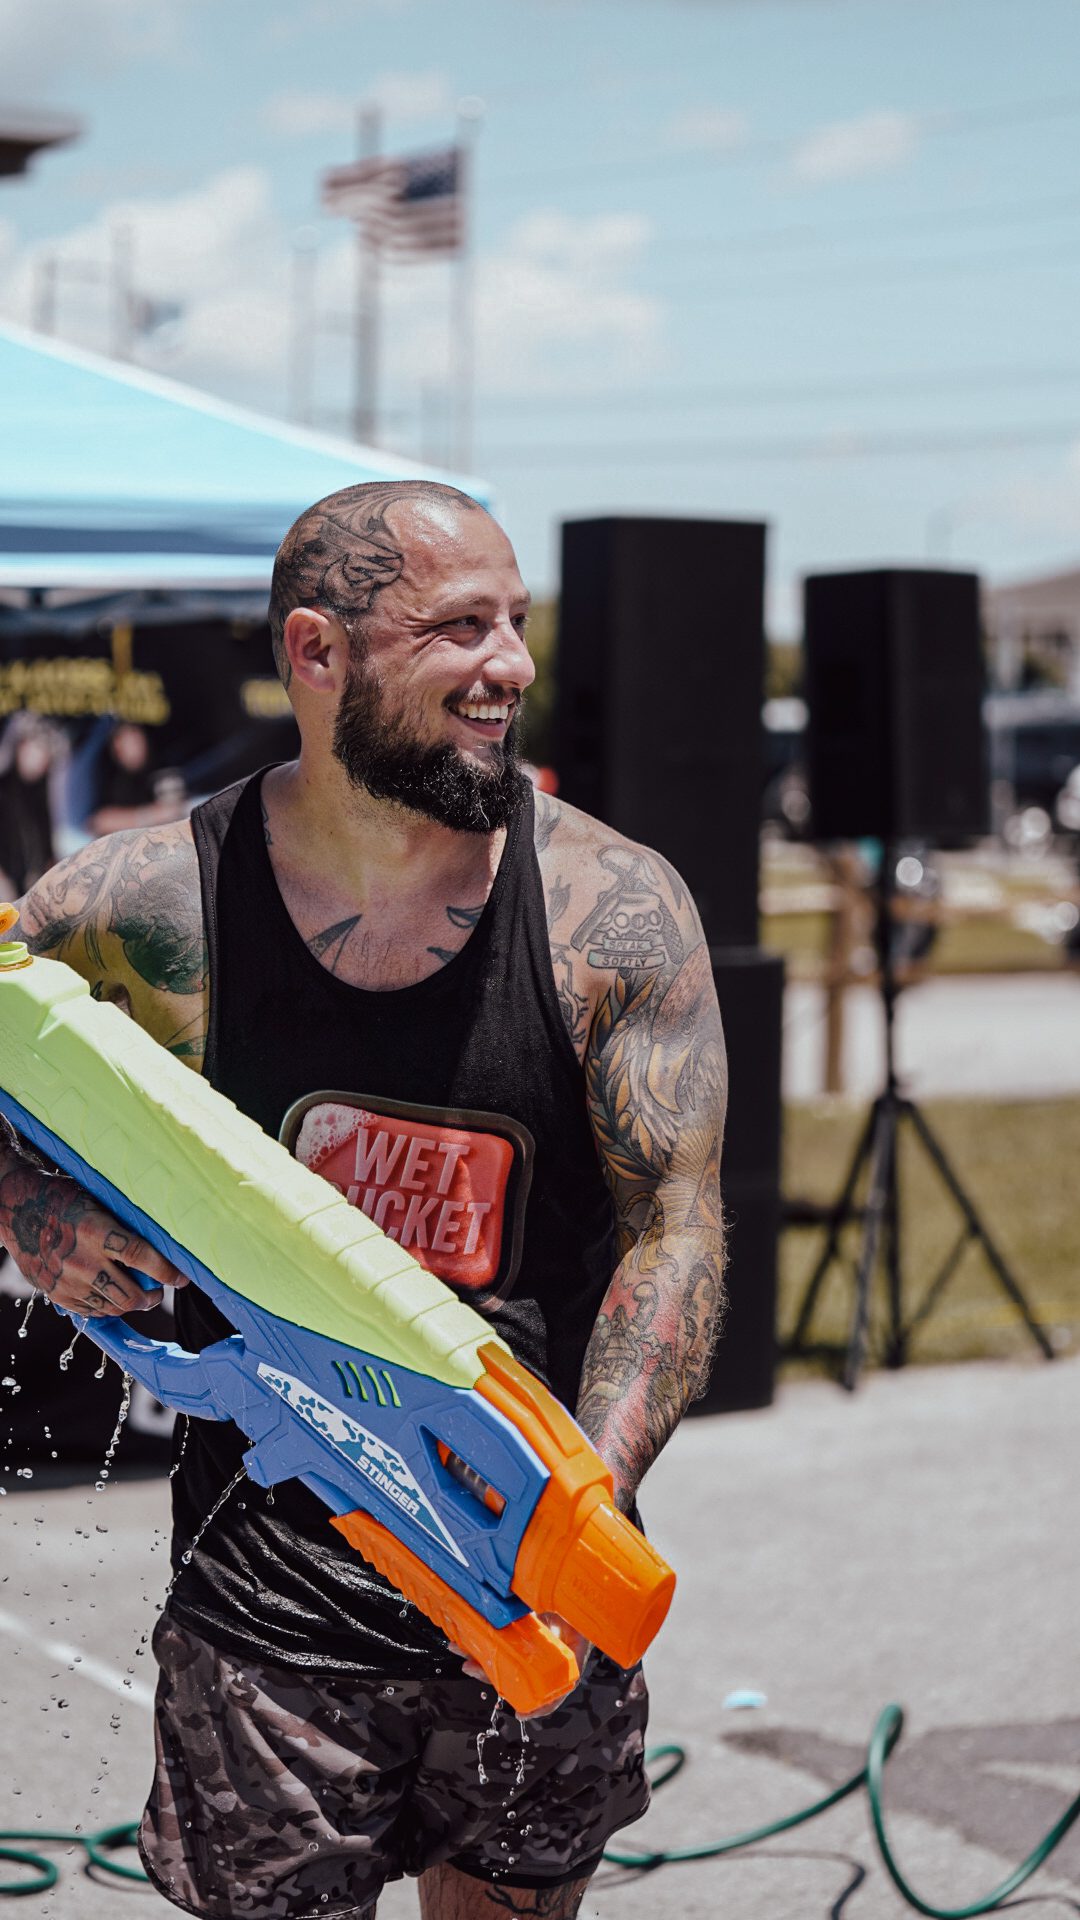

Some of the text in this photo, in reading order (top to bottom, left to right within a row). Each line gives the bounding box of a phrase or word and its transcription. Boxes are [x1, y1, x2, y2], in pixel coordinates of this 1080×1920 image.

[602, 957, 648, 967] SOFTLY
[609, 940, 645, 950] SPEAK
[354, 1128, 470, 1195] WET
[332, 1183, 491, 1255] CKET
[357, 1455, 420, 1515] STINGER
